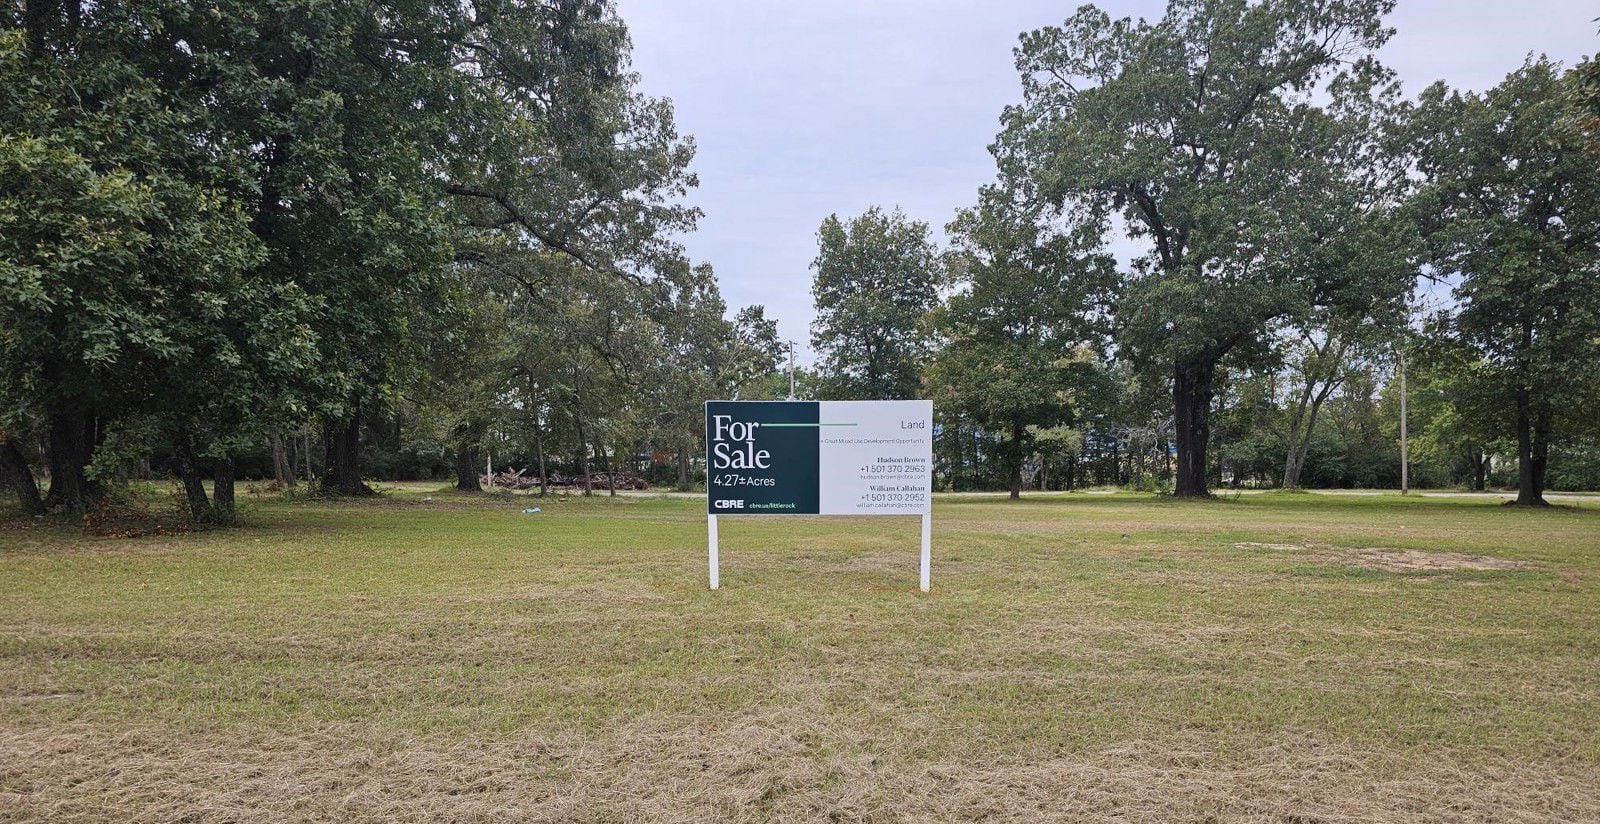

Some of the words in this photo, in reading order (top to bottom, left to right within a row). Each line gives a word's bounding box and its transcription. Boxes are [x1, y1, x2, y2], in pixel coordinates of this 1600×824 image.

[713, 415, 759, 441] For
[901, 420, 925, 429] Land
[714, 442, 770, 468] Sale
[715, 500, 744, 508] CBRE
